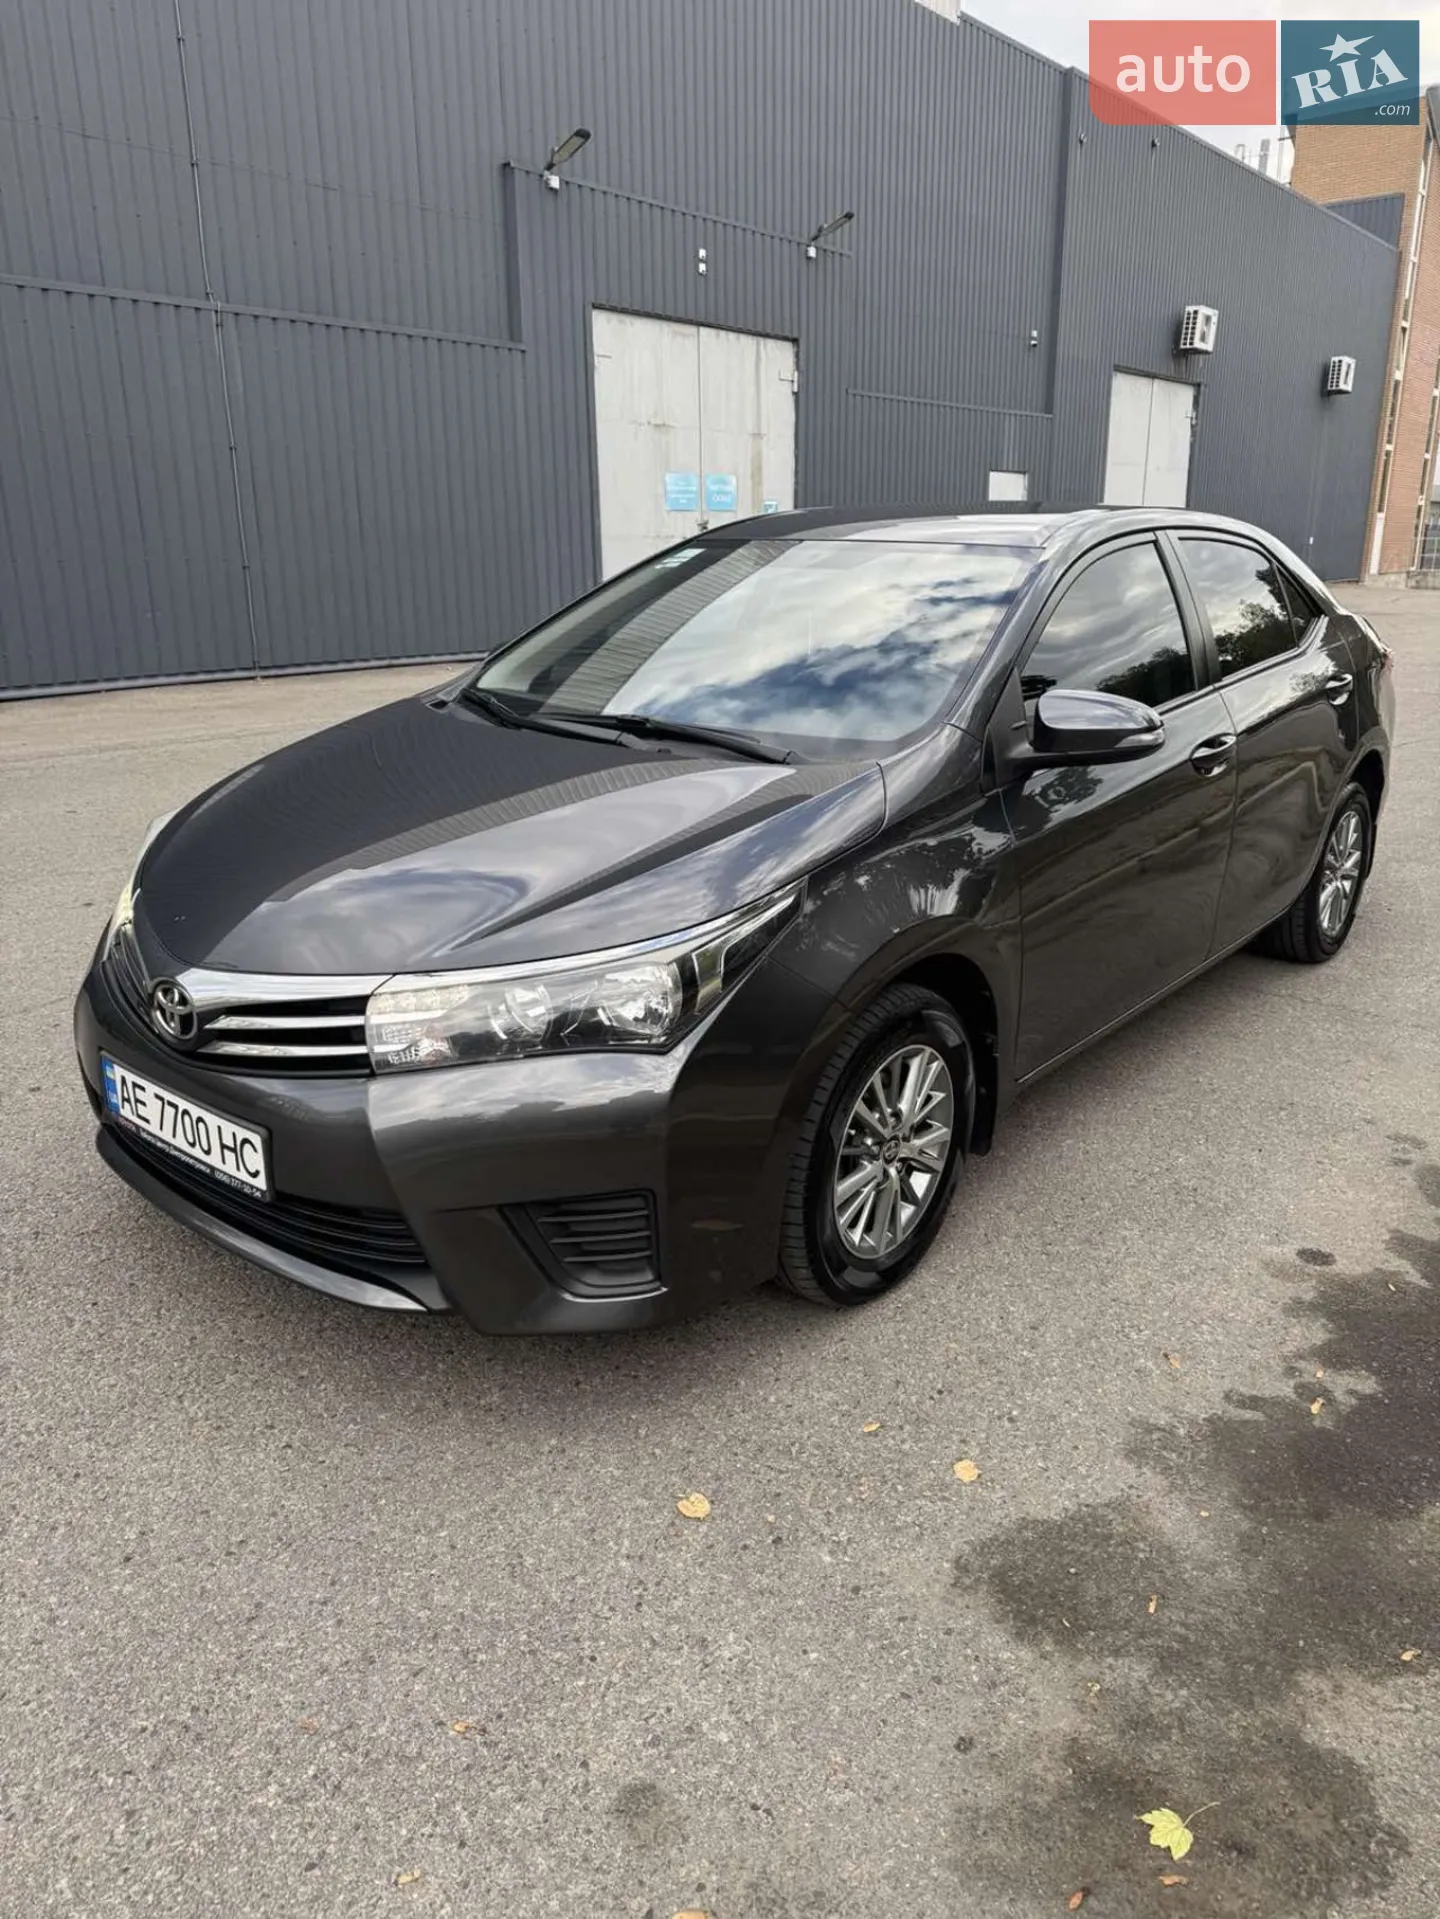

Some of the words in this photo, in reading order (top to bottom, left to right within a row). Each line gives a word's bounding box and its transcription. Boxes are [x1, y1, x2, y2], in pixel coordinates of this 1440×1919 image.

[121, 1074, 151, 1125] AE
[154, 1092, 212, 1156] 7700
[217, 1125, 261, 1179] HC
